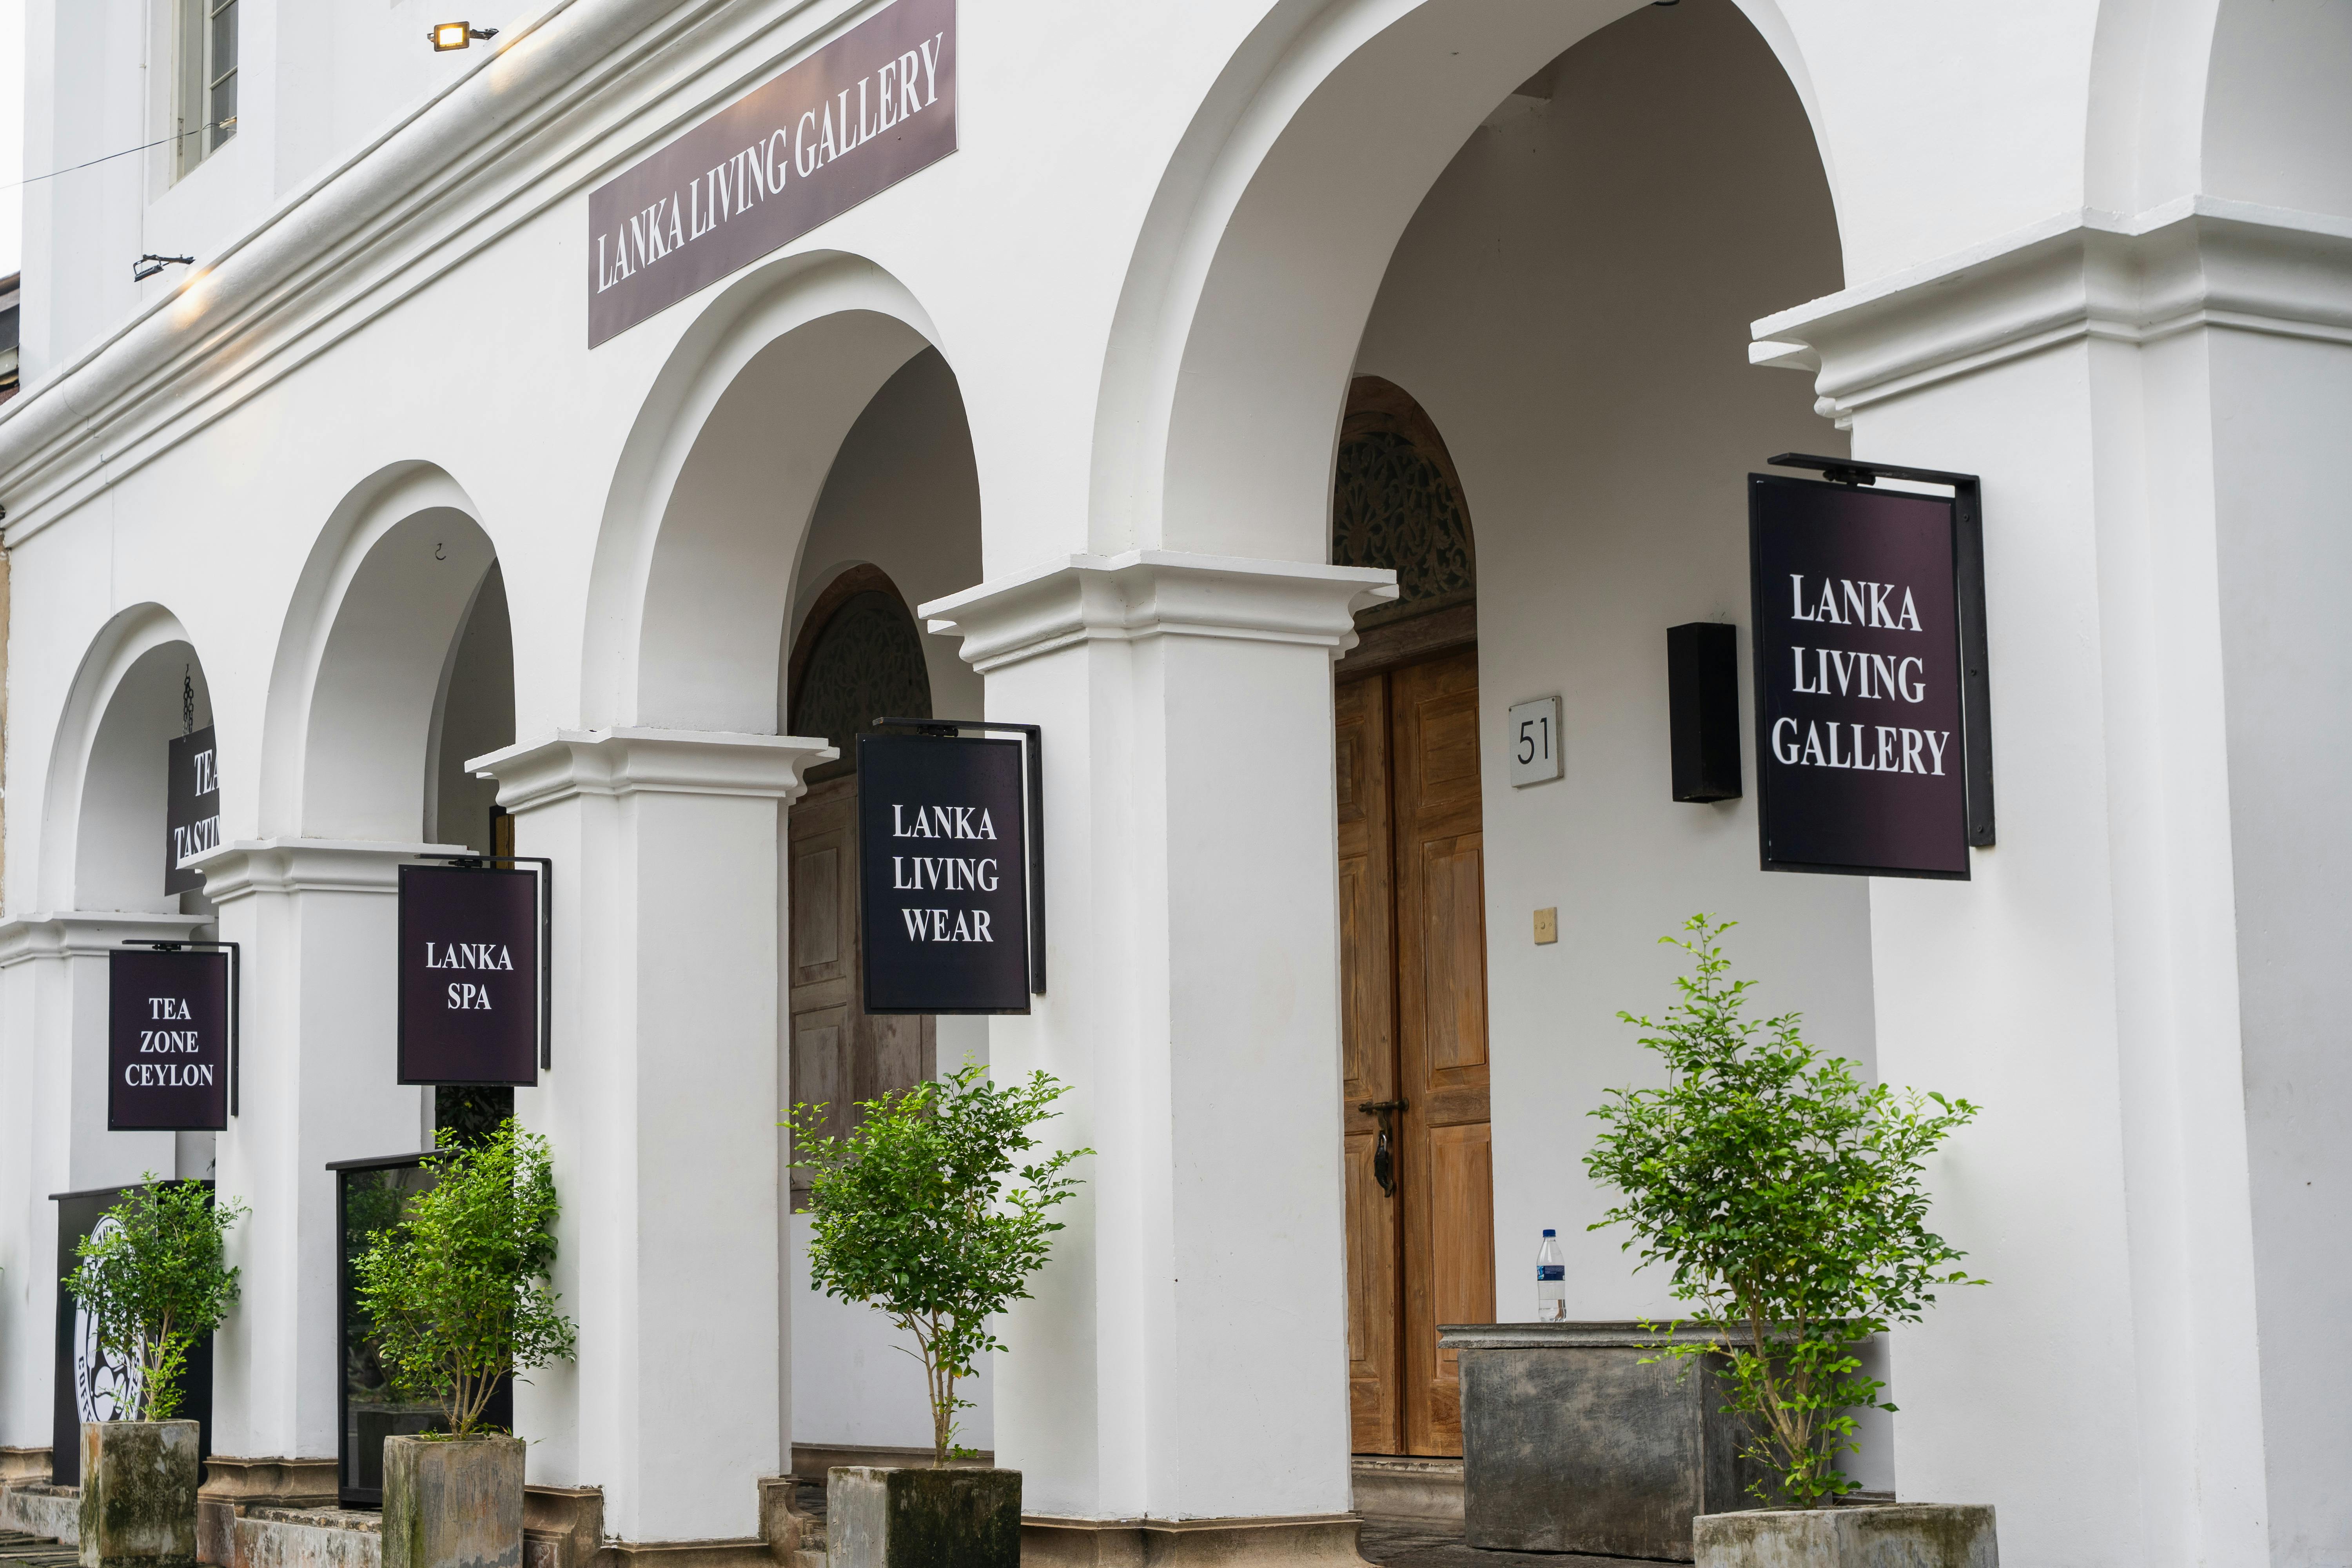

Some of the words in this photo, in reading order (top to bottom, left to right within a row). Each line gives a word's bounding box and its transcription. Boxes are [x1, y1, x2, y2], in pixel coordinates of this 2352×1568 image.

[597, 191, 685, 294] LANKA
[689, 125, 788, 241] LIVING
[795, 31, 943, 178] GALLERY
[1790, 574, 1923, 632] LANKA
[1791, 646, 1926, 703] LIVING
[1517, 717, 1548, 765] 51
[1772, 717, 1950, 776] GALLERY
[194, 749, 220, 797] TEA
[892, 804, 997, 840] LANKA
[892, 857, 999, 891] LIVING
[901, 909, 994, 942] WEAR
[426, 942, 514, 970] LANKA
[149, 998, 192, 1020] TEA
[448, 983, 492, 1009] SPA
[140, 1031, 199, 1053] ZONE
[125, 1064, 214, 1086] CEYLON
[79, 1356, 93, 1422] COFFE
